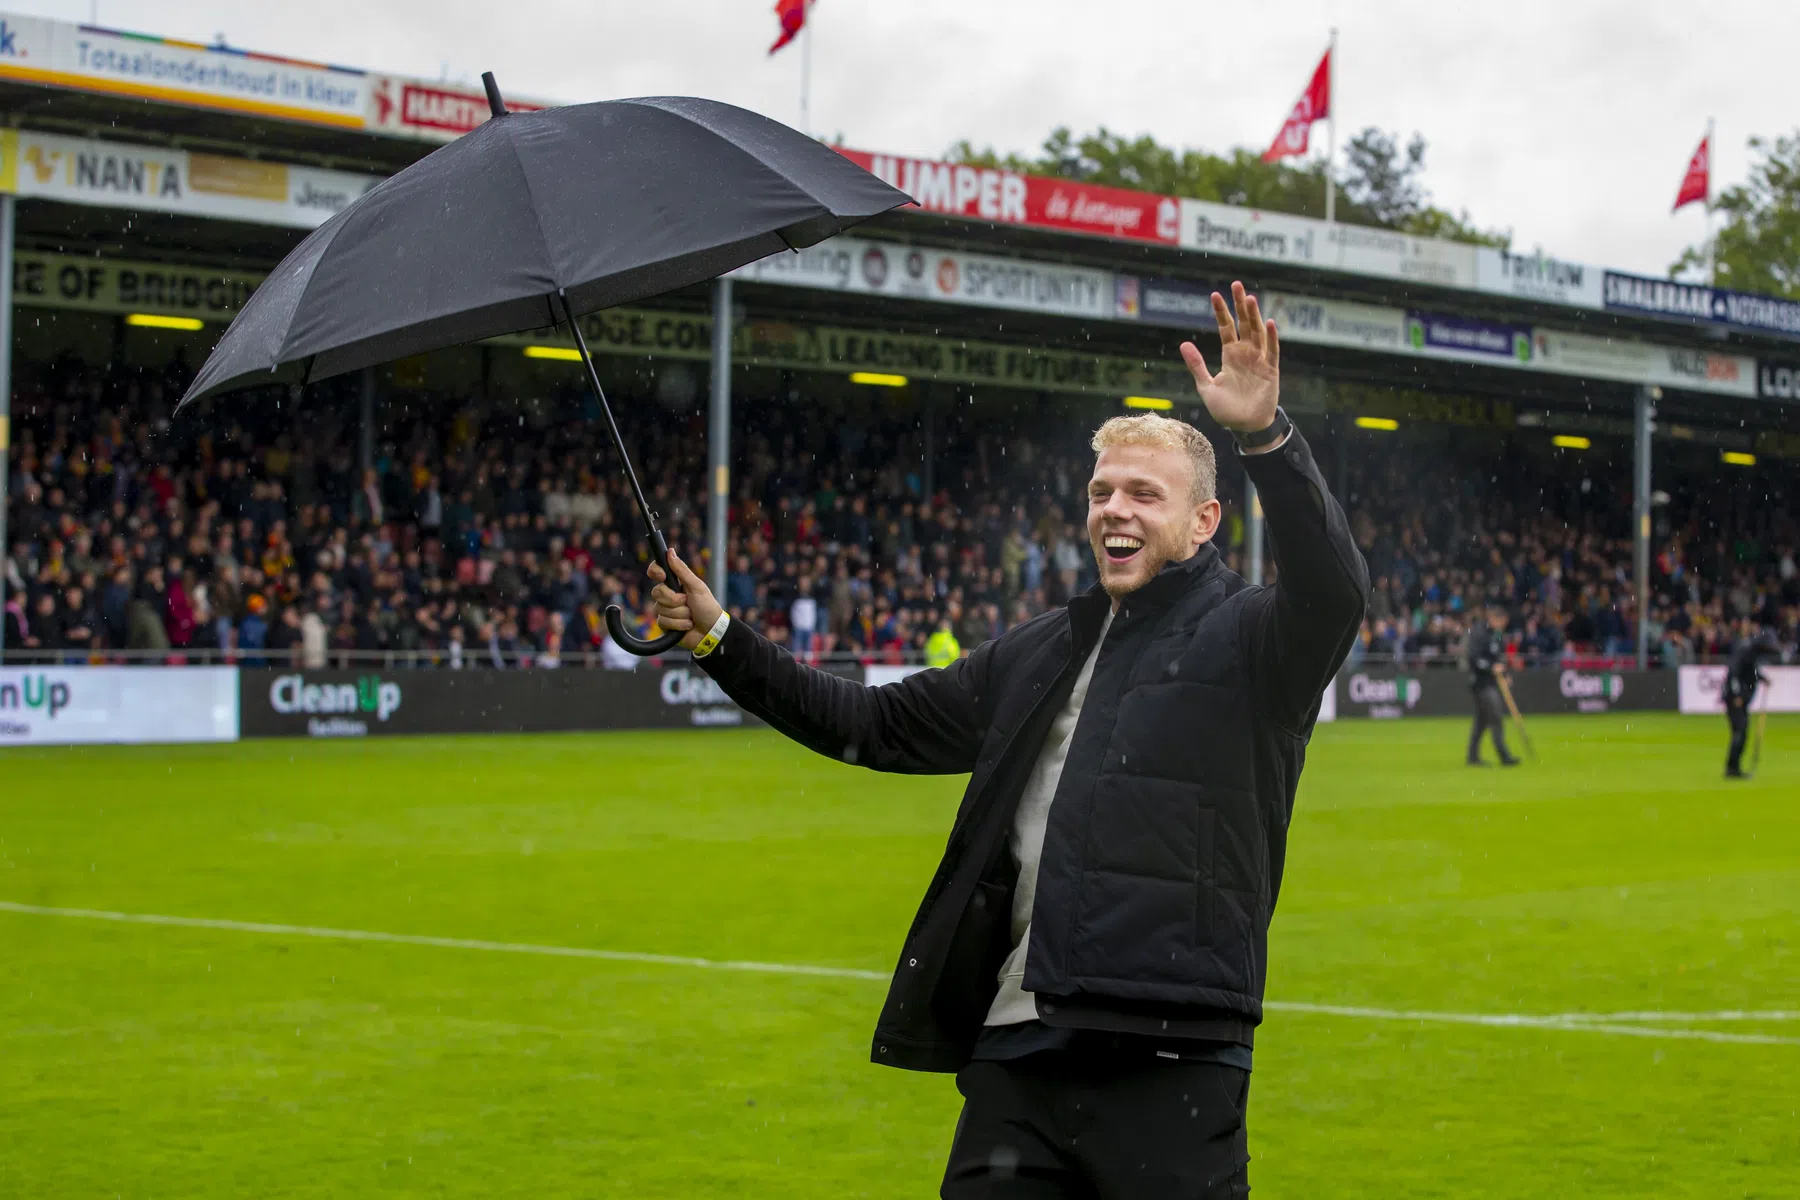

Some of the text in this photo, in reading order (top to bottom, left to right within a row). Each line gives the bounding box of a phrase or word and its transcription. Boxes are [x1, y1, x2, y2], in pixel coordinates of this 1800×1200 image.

[77, 40, 358, 108] Totaalonderhoud in kleur
[873, 154, 1028, 224] UMPER
[58, 265, 105, 302] OF
[270, 675, 401, 720] CleanUp
